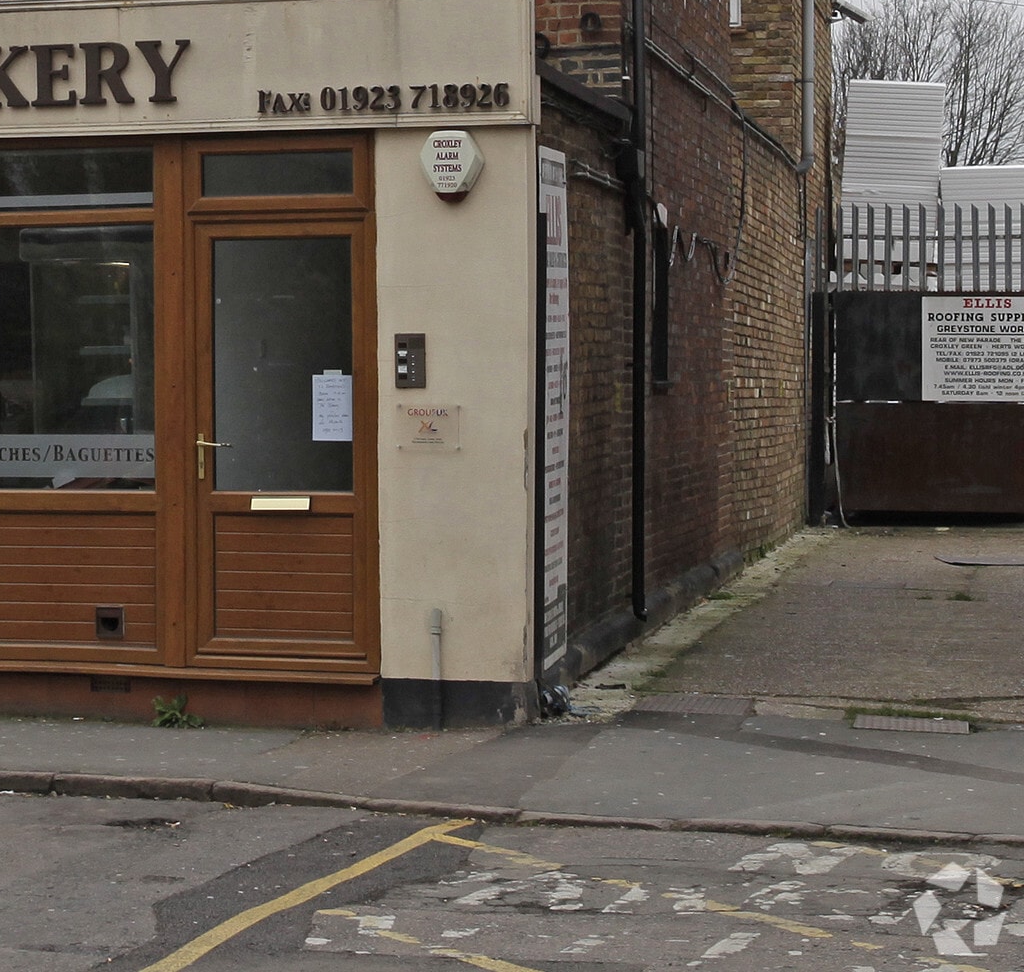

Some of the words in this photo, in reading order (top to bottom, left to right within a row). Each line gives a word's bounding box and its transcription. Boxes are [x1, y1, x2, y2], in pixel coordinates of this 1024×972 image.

[257, 90, 310, 114] FAX:
[319, 84, 400, 111] 01923
[409, 82, 510, 110] 718926
[432, 139, 462, 149] CROXLEY
[435, 151, 459, 161] ALARM
[433, 163, 462, 173] SYSTEMS
[963, 298, 1012, 309] ELLIS
[927, 312, 984, 322] ROOFING
[990, 312, 1024, 322] SUPP
[936, 325, 996, 333] GREYSTONE
